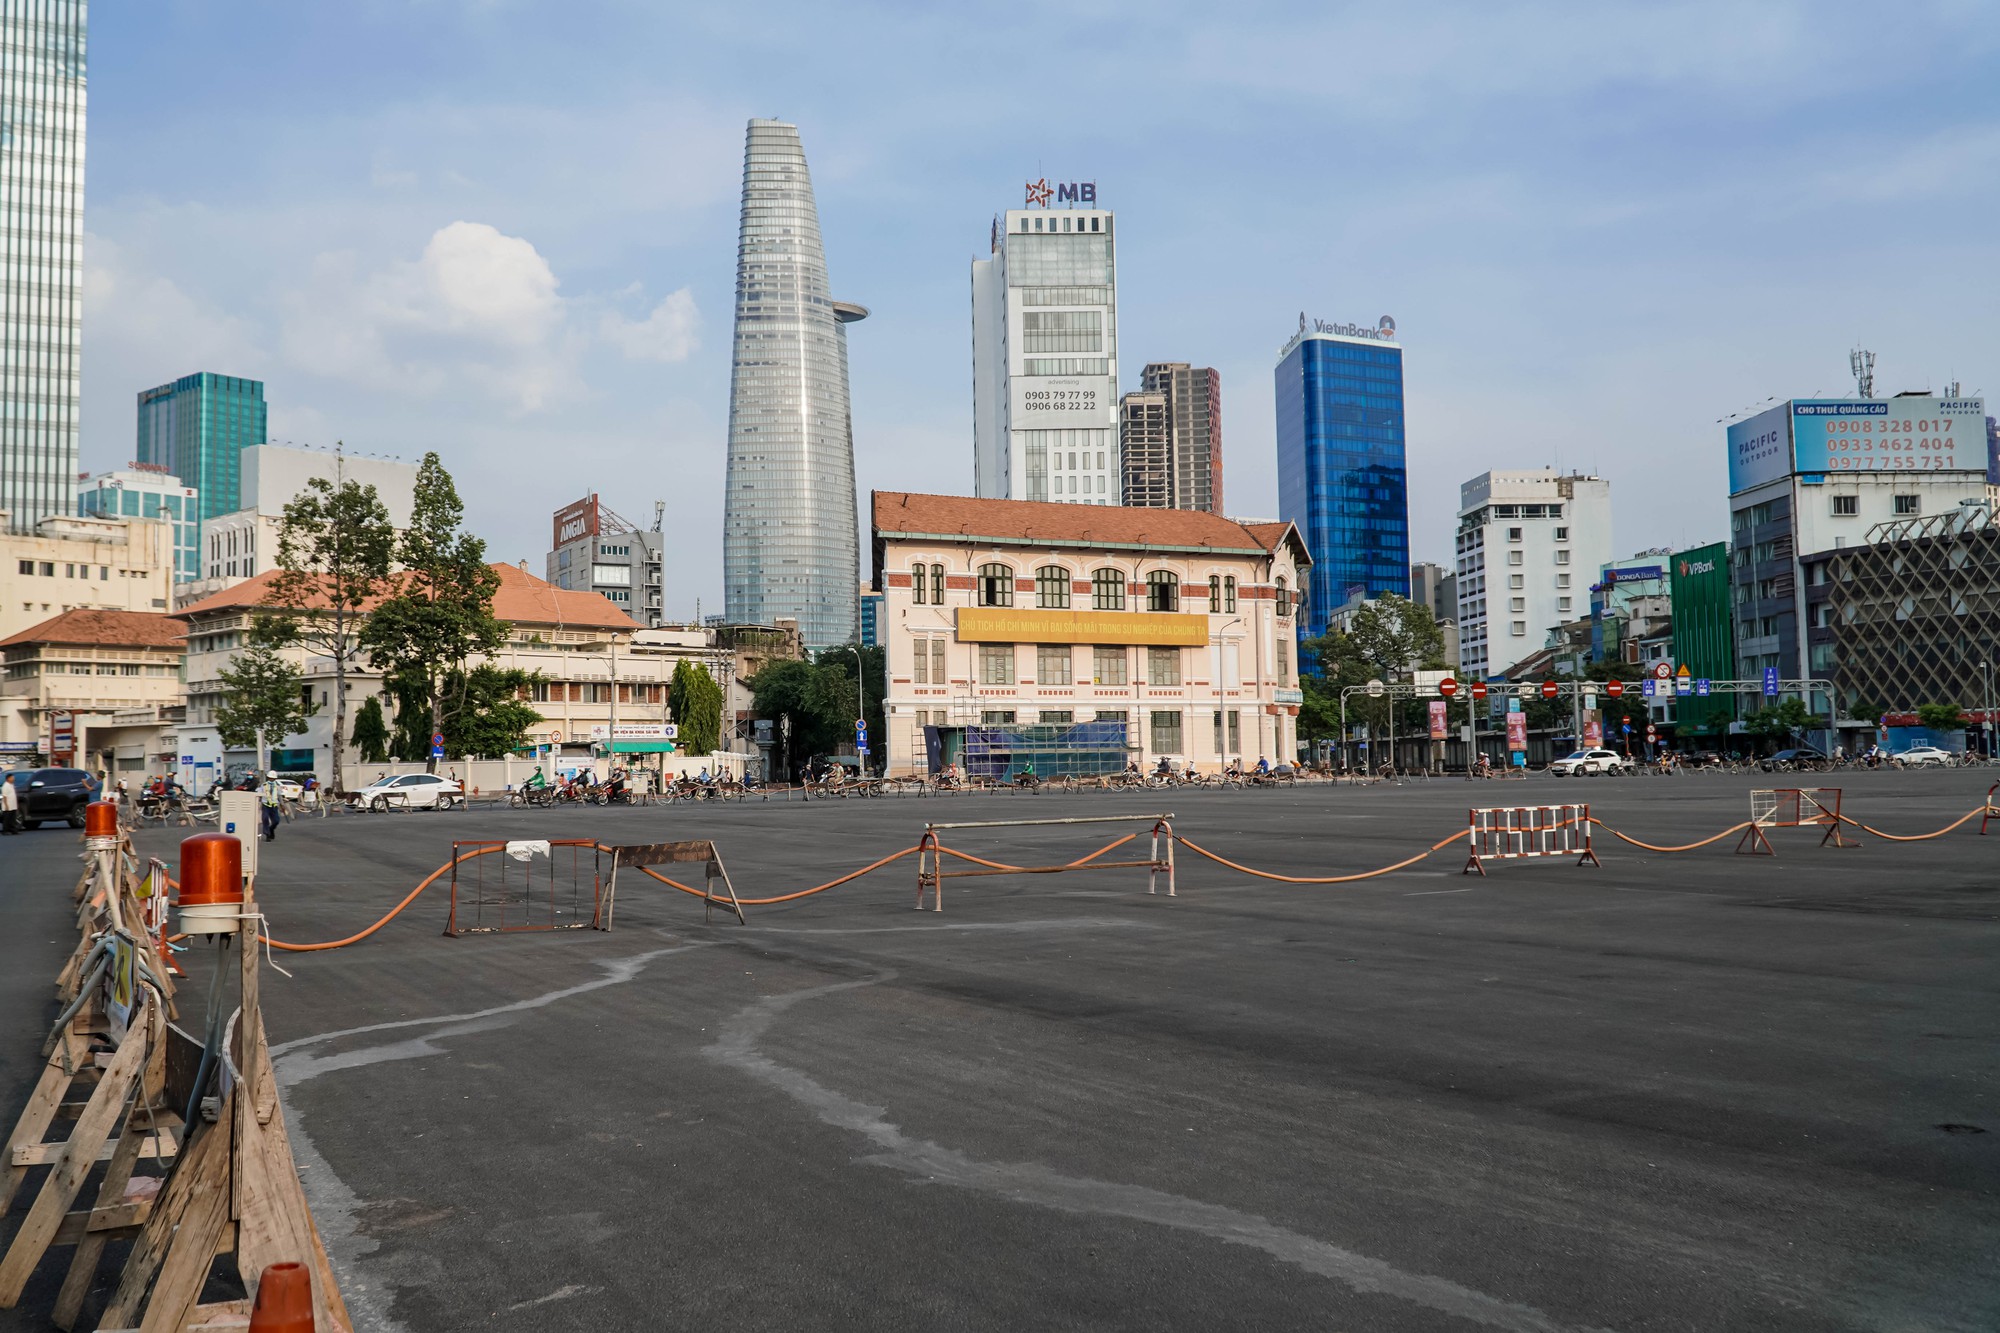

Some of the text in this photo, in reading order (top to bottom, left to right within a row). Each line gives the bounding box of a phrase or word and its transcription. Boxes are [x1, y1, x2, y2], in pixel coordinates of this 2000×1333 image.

[1058, 183, 1096, 202] MB
[1025, 391, 1095, 399] 0903 79 77 99
[1025, 402, 1095, 410] 0906 68 22 22
[1797, 404, 1886, 414] CHO THUÊ QUẢNG CÁO
[1826, 419, 1953, 433] 0908 328 017
[1739, 430, 1778, 455] PACIFIC
[1827, 438, 1954, 451] 0933 462 404
[1740, 446, 1779, 466] OUTDOOR
[1828, 455, 1954, 469] 0977 755 751
[1689, 559, 1715, 576] VPBank
[1021, 621, 1040, 632] MINH
[1098, 623, 1121, 634] TRONG
[1196, 625, 1206, 636] TA
